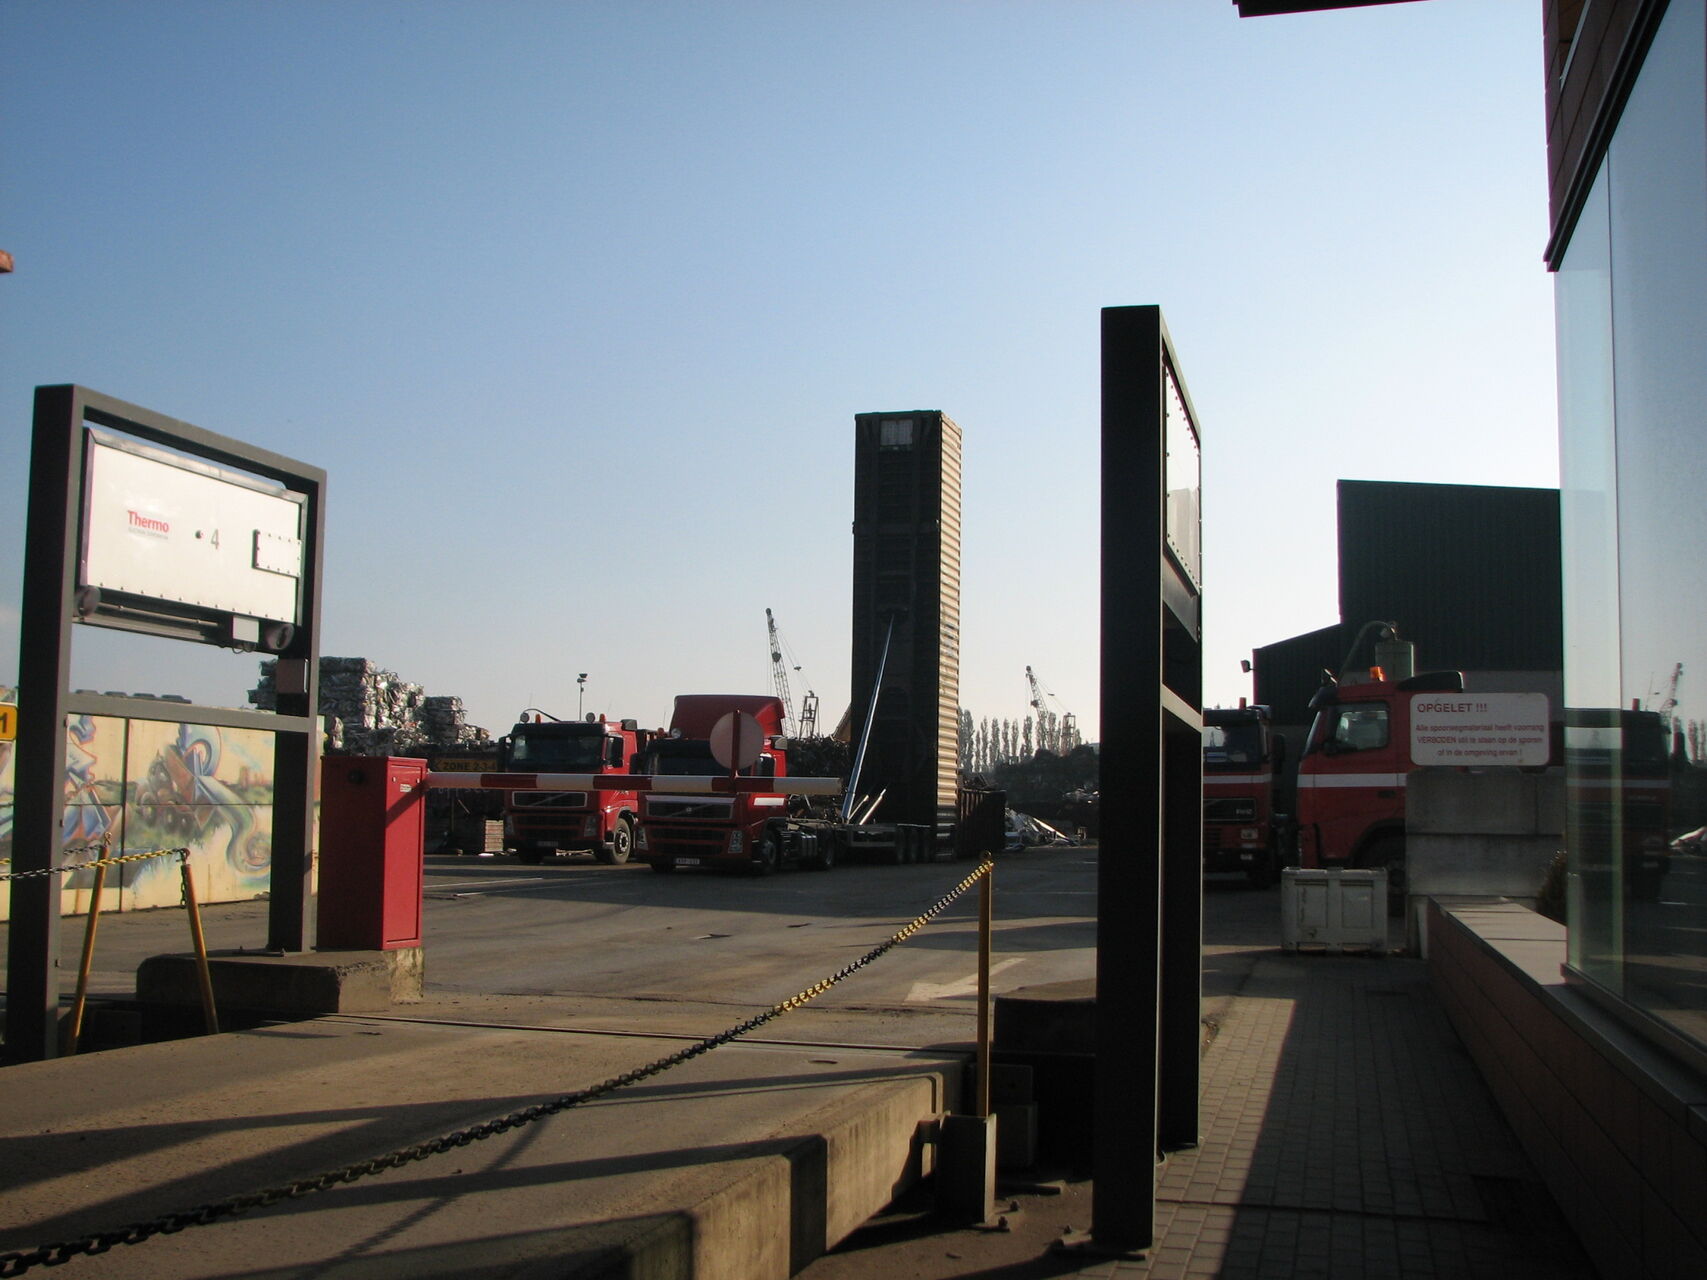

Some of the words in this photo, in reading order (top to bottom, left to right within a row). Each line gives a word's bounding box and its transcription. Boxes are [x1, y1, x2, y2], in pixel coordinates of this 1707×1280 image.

[127, 509, 169, 533] Thermo
[210, 528, 219, 550] 4
[1416, 703, 1472, 713] OPGELET
[1475, 703, 1488, 713] !!!
[1416, 736, 1456, 744] VERBODEN
